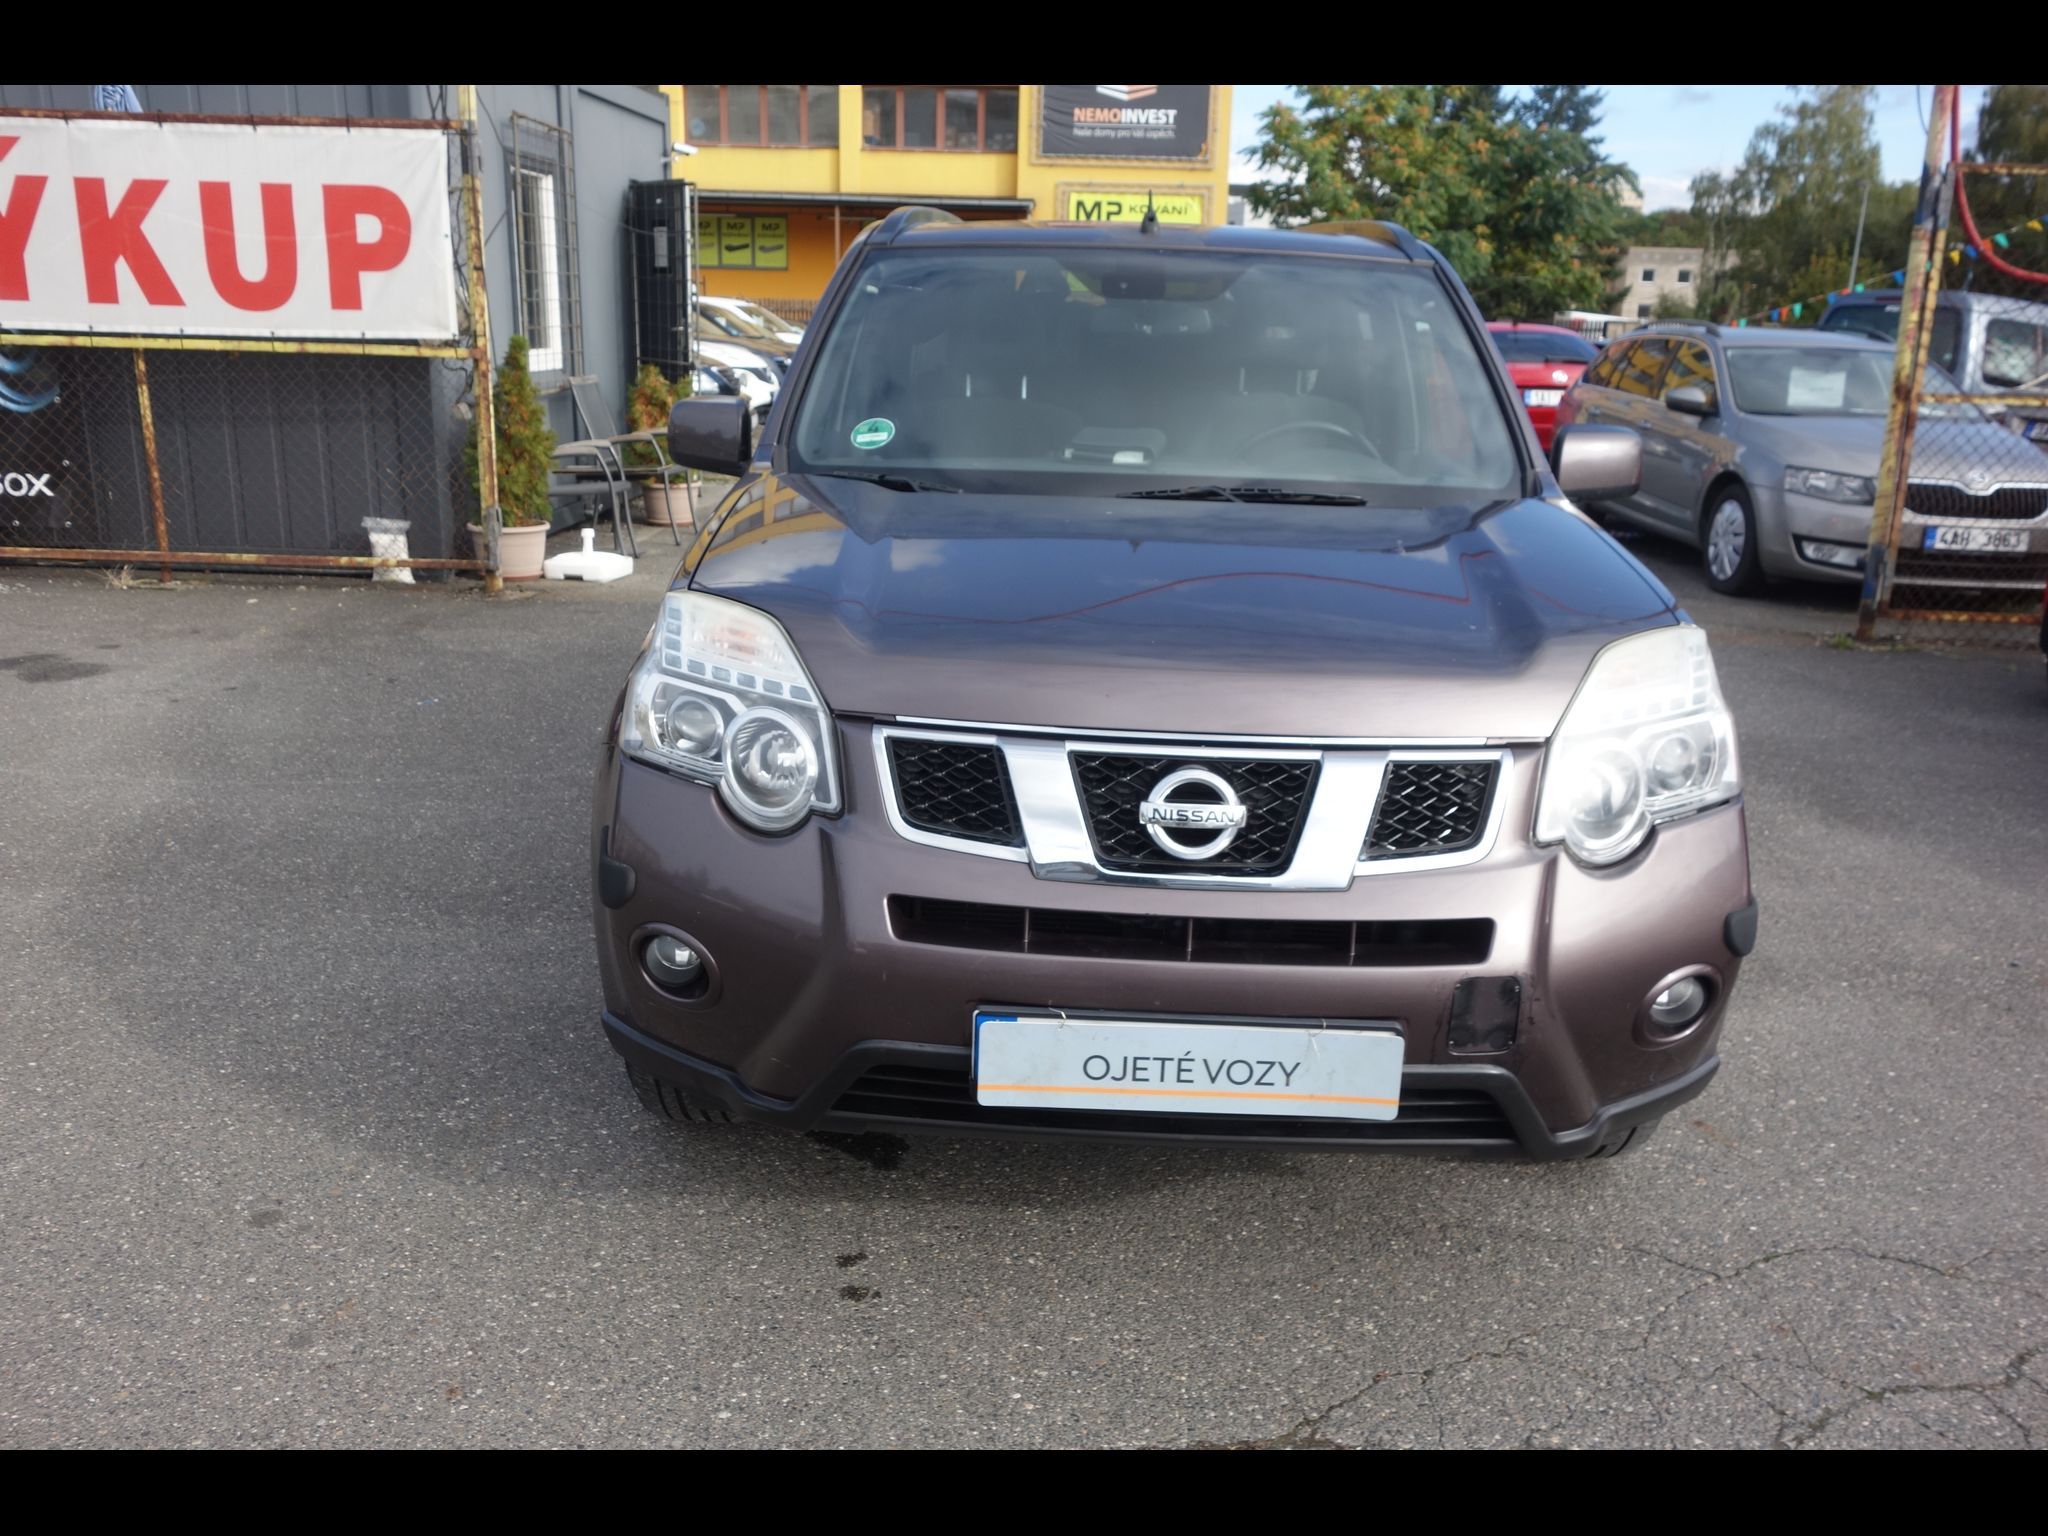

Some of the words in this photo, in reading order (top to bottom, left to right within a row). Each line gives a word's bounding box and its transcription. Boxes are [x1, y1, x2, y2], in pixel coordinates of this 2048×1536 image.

[1073, 107, 1177, 124] NEMOINVEST
[1076, 201, 1122, 221] MP
[0, 472, 55, 497] OX
[1152, 807, 1236, 823] NISSAN
[1083, 1050, 1195, 1084] OJETÉ
[1202, 1058, 1301, 1087] VOZY
